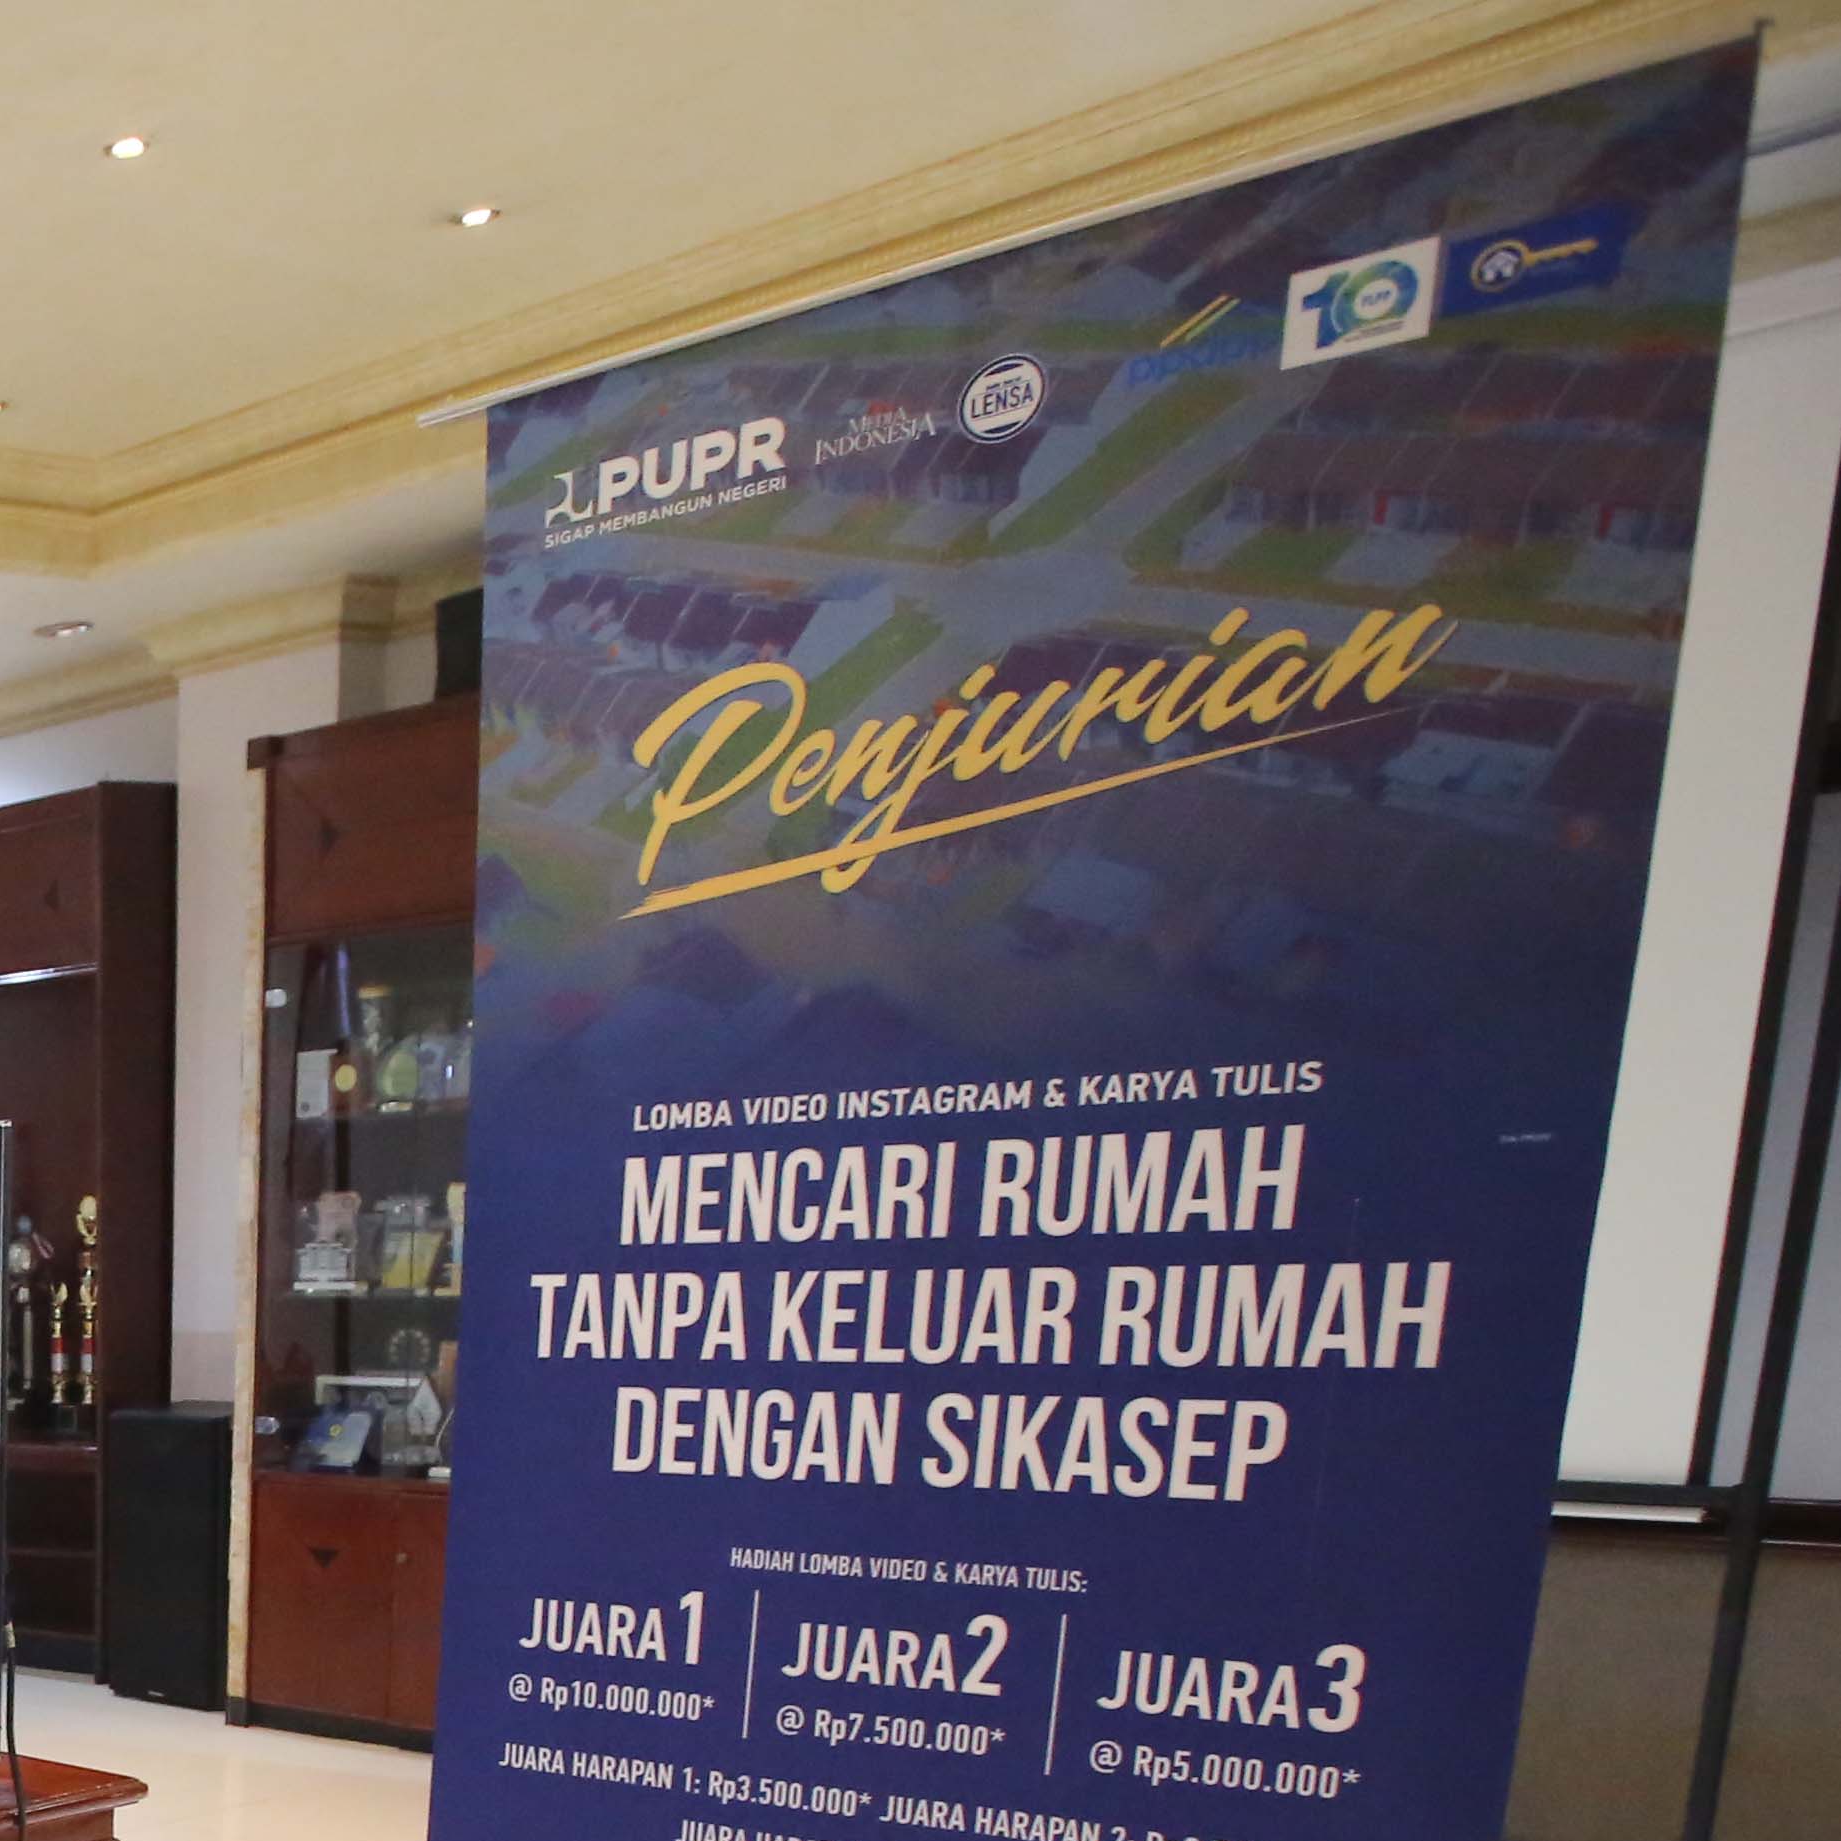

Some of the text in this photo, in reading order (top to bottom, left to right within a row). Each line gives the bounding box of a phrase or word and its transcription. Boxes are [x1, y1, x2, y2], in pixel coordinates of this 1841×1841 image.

[971, 382, 1033, 418] LENSA
[597, 416, 787, 515] PUPR
[815, 412, 937, 465] INDONESIA
[544, 475, 787, 549] SIGAP MEMBANGUN NEGERI
[633, 603, 1459, 893] Penjurian
[633, 1060, 1324, 1132] LOMBA VIDEO INSTAGRAM & KARYA TULIS
[618, 1123, 1306, 1247] MENCARI RUMAH
[530, 1260, 1452, 1369] TANPA KELUAR RUMAH
[611, 1385, 1288, 1502] DENGAN SIKASEP
[730, 1547, 1088, 1594] HADIAH LOMBA VIDEO & KARYA TULIS:
[519, 1589, 706, 1666] JUARA 1
[781, 1621, 956, 1694] JUARA
[508, 1671, 533, 1704] @
[775, 1703, 805, 1737] @
[1096, 1648, 1300, 1730] JUARA
[499, 1742, 565, 1778] JUARA
[571, 1752, 674, 1793] HARAPAN
[681, 1766, 701, 1796] 1:
[1088, 1739, 1122, 1777] @
[880, 1794, 967, 1834] JUARA
